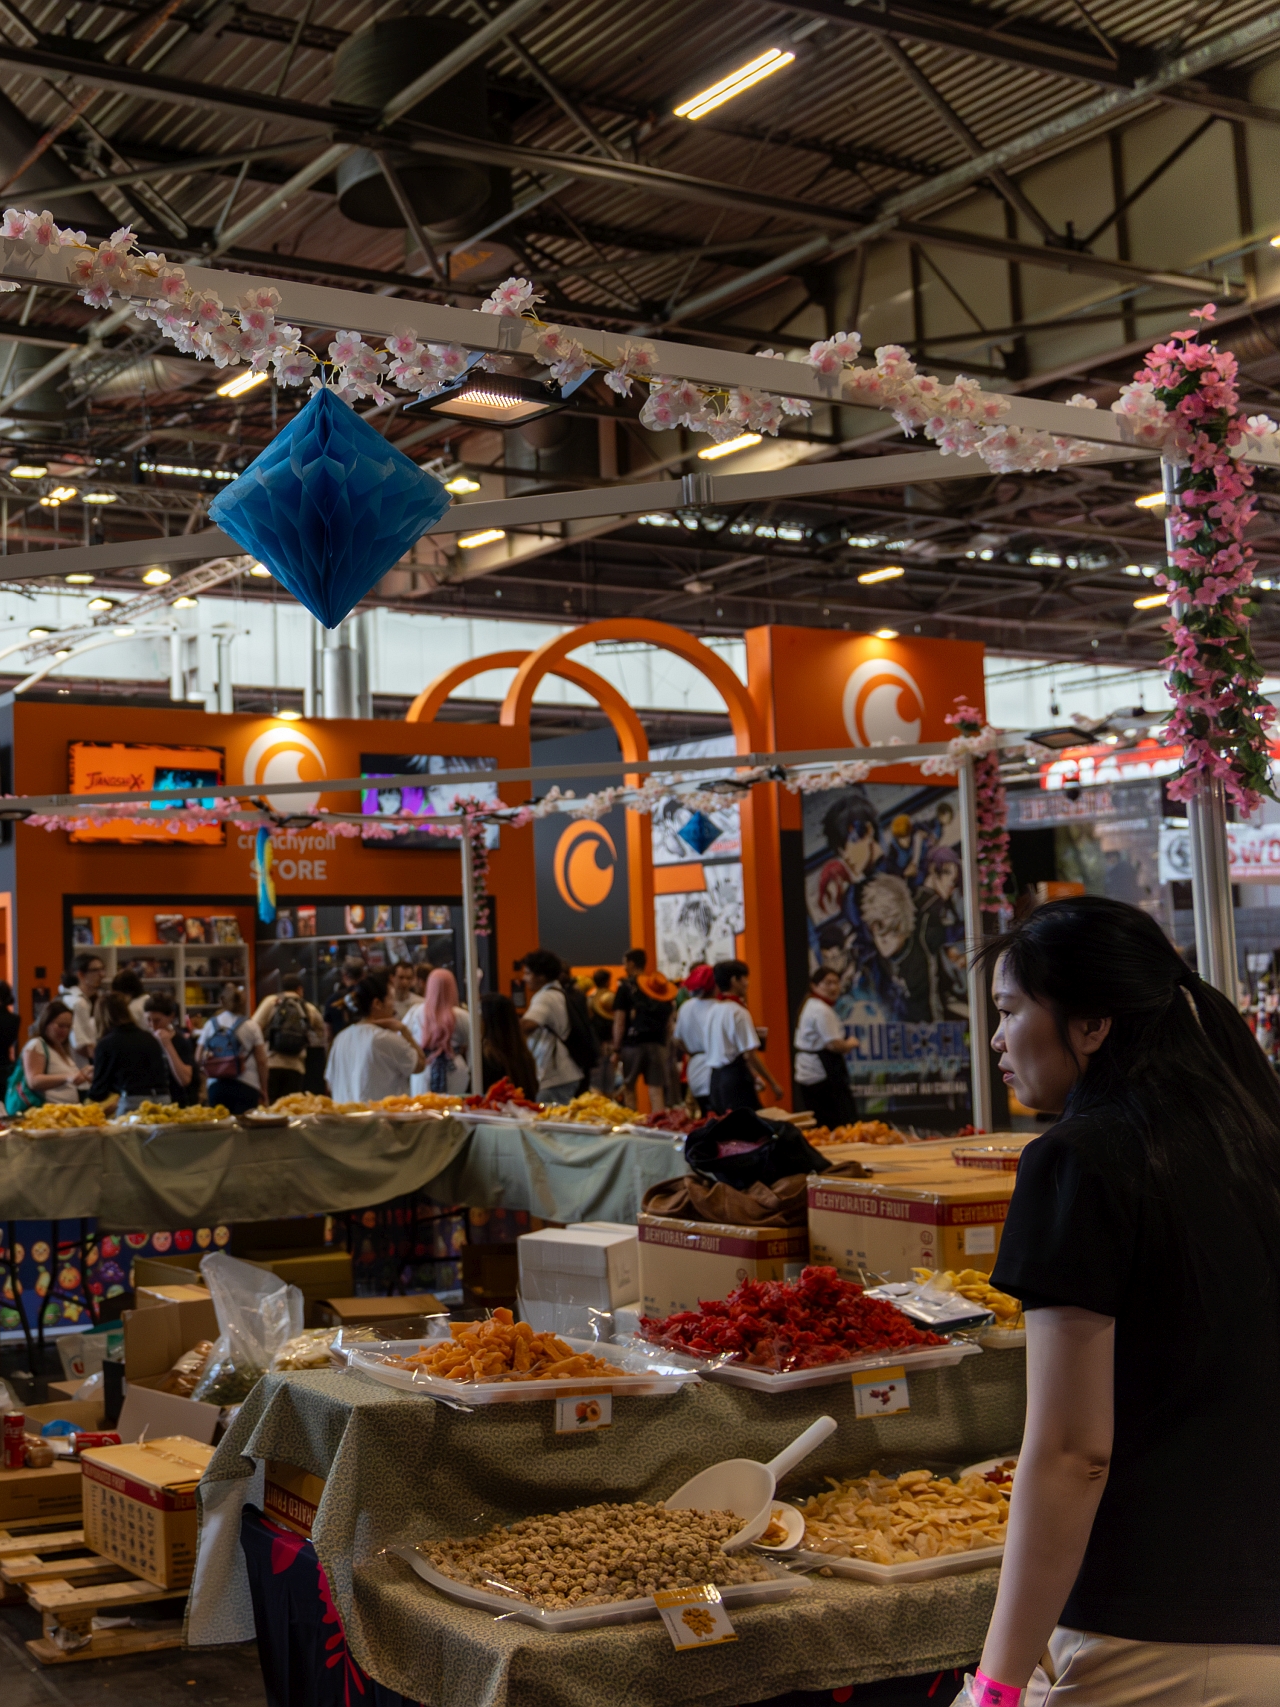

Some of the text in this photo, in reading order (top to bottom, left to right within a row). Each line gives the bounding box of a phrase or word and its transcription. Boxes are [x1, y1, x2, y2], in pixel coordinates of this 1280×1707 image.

[237, 833, 336, 854] crnchyroll
[249, 858, 328, 881] SORE
[814, 1192, 910, 1219] DEHYDRATED FRUIT
